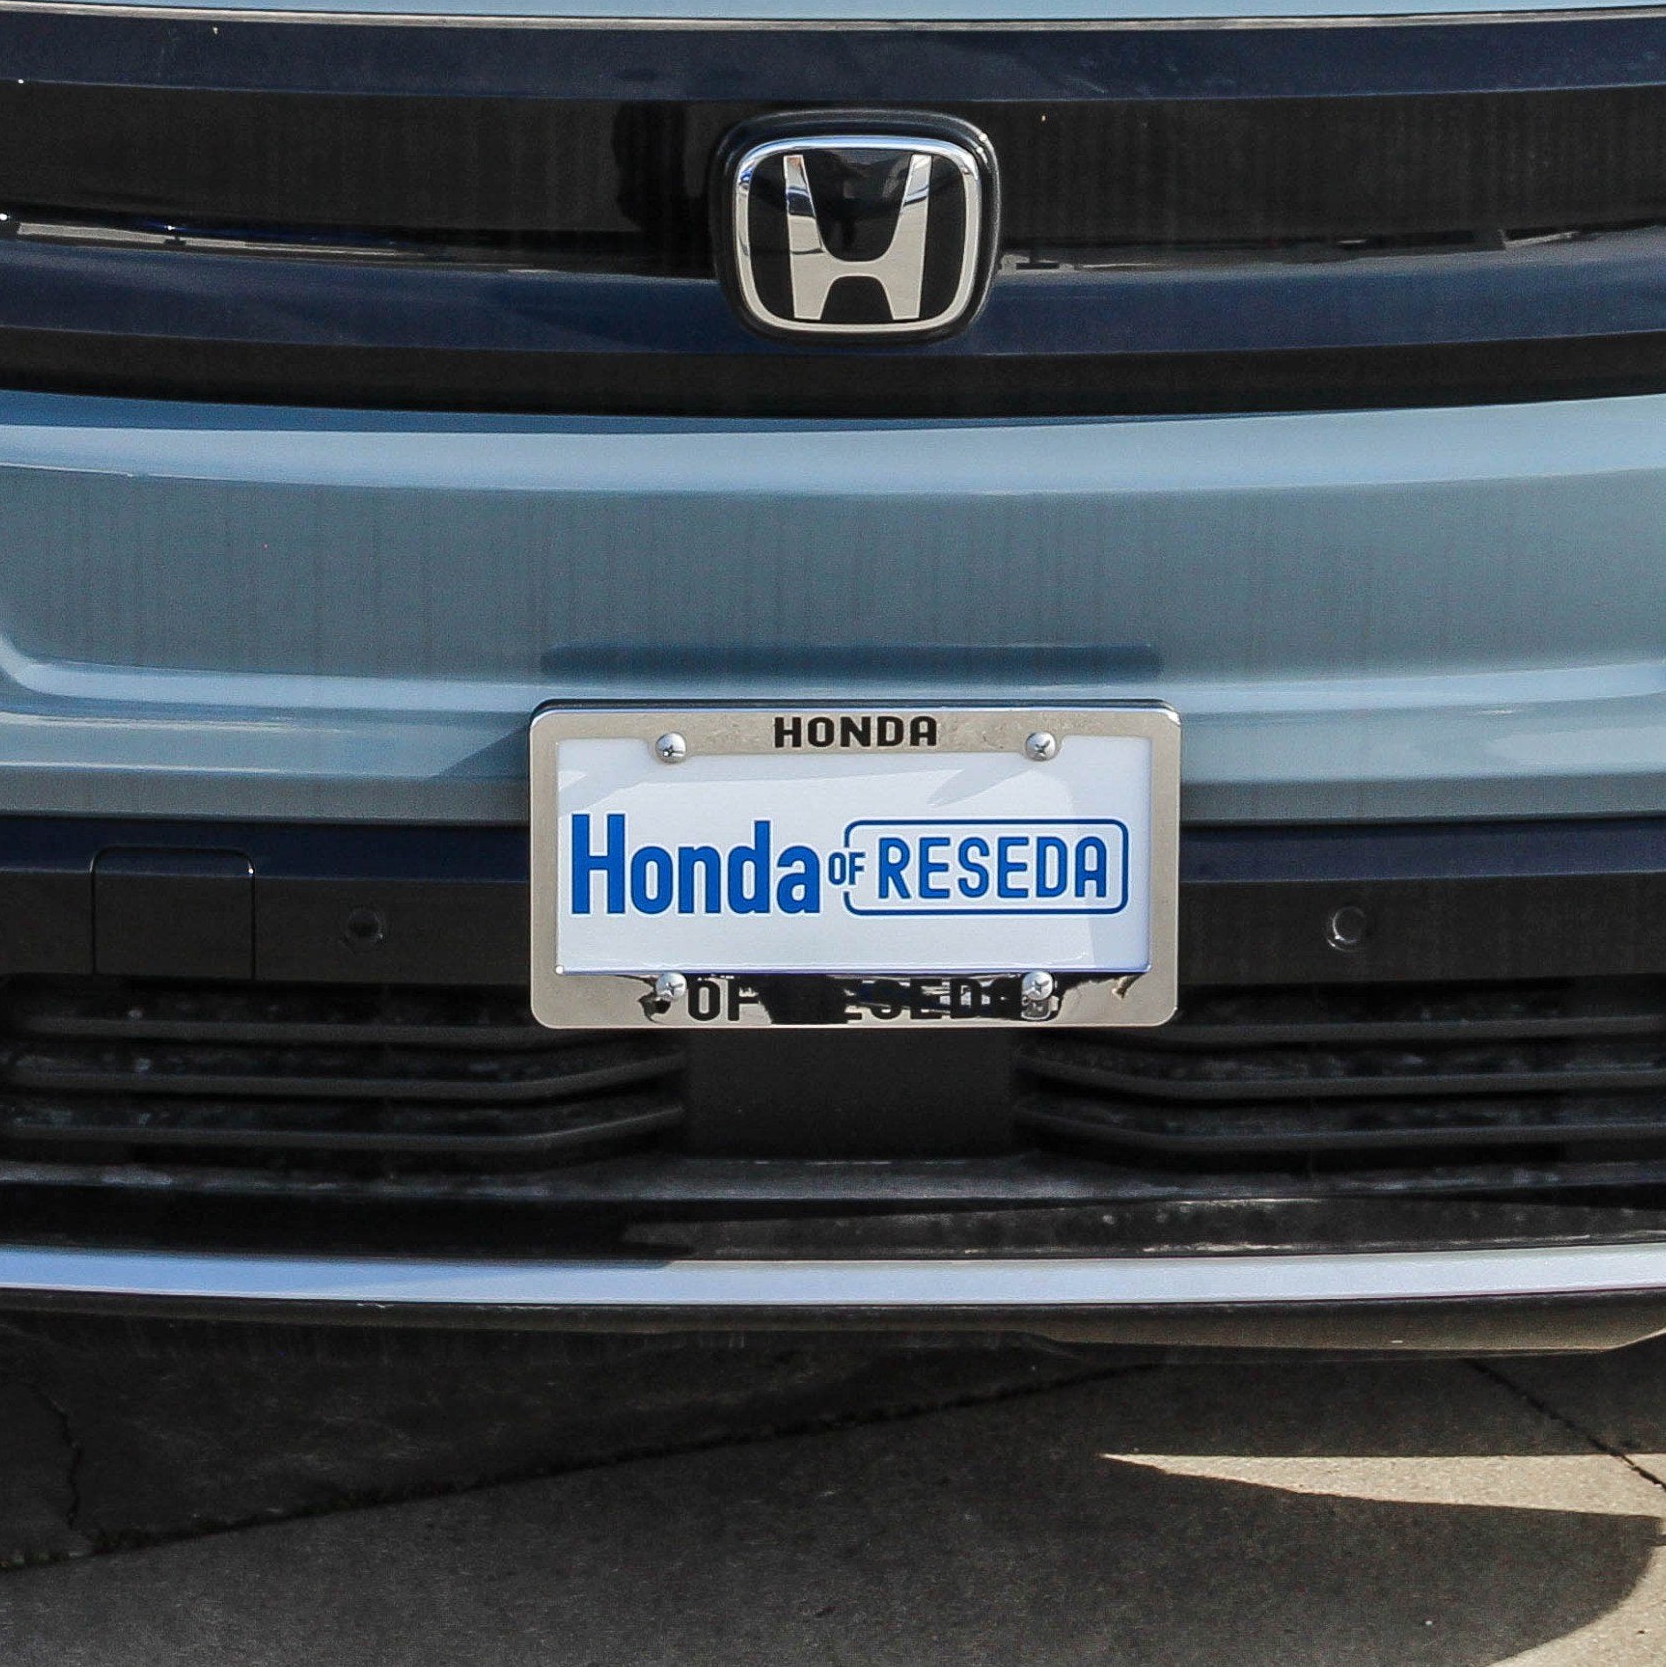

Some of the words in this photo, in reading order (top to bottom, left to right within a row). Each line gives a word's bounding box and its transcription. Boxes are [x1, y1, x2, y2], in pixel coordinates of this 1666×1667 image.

[775, 716, 936, 748] HONDA
[572, 814, 820, 914] Honda
[829, 852, 864, 885] OF
[879, 836, 1107, 899] RESEDA
